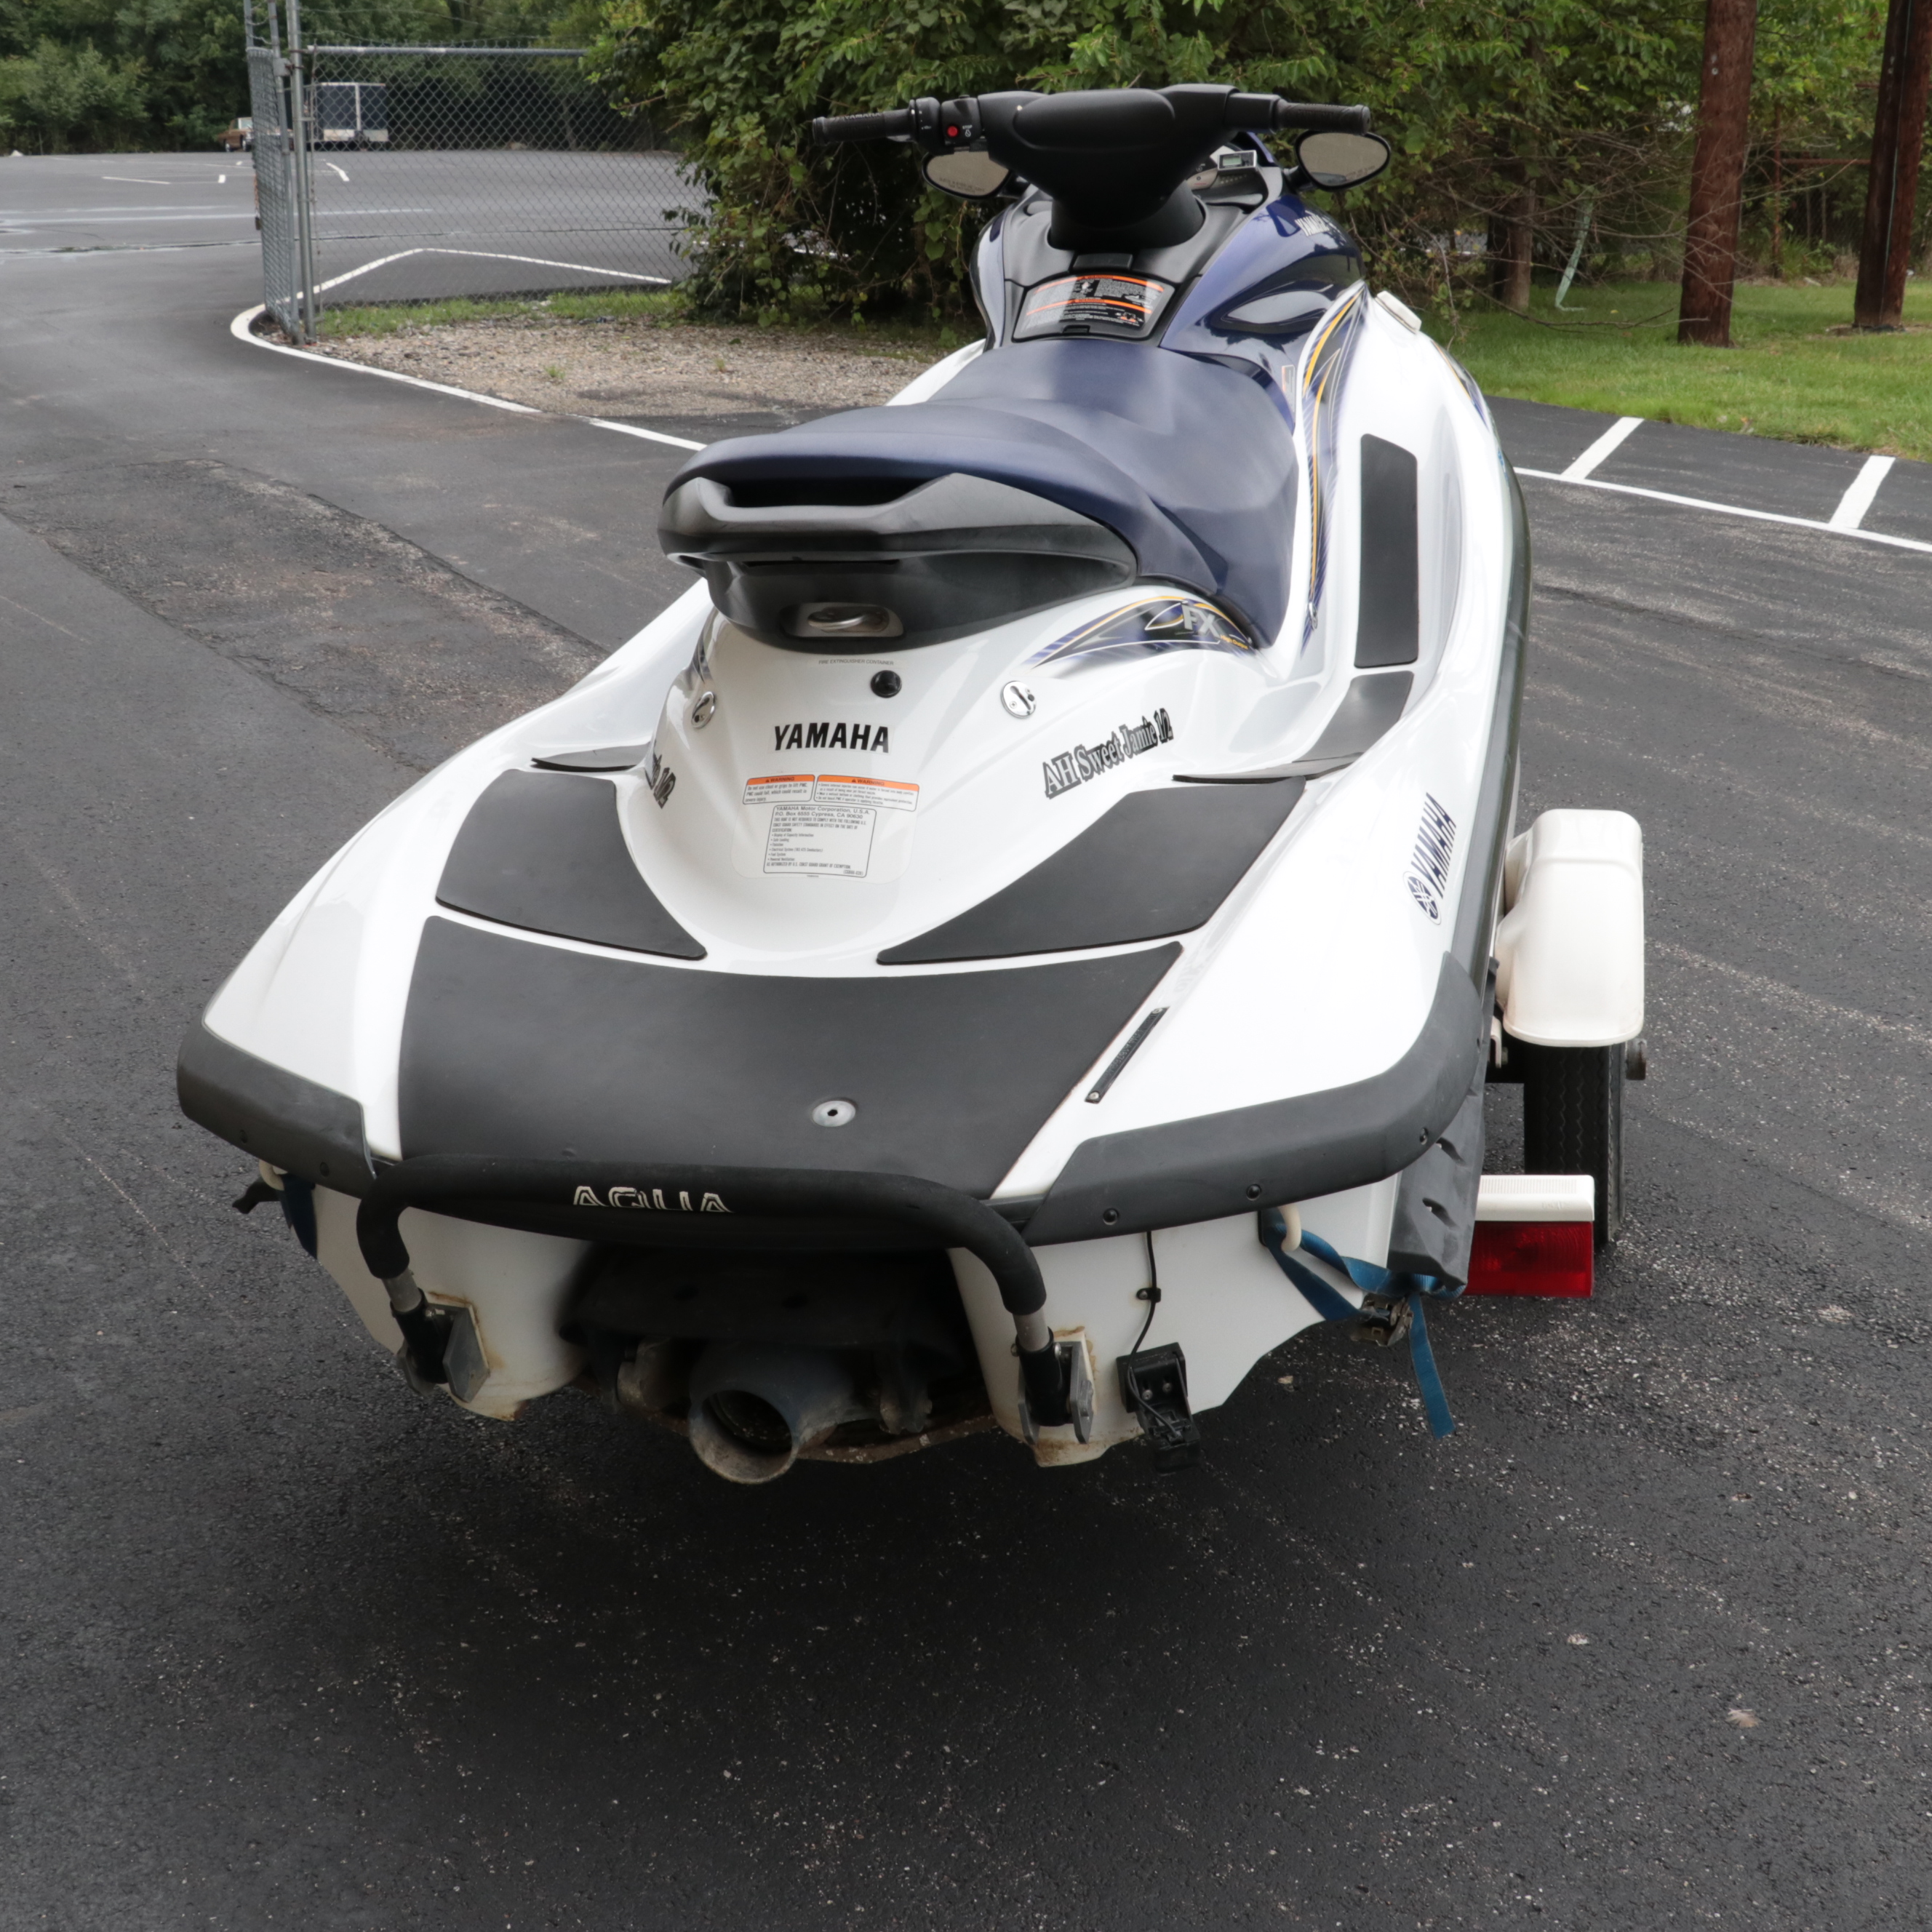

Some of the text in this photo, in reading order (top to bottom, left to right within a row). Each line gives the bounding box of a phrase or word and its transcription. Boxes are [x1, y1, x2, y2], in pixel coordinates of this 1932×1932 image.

[1181, 603, 1221, 639] FX
[774, 722, 889, 754] YAMAHA
[1042, 751, 1082, 799] AH
[1074, 731, 1125, 782] Sweet
[1119, 715, 1159, 759] Jamie
[1410, 791, 1457, 899] YAMAHA
